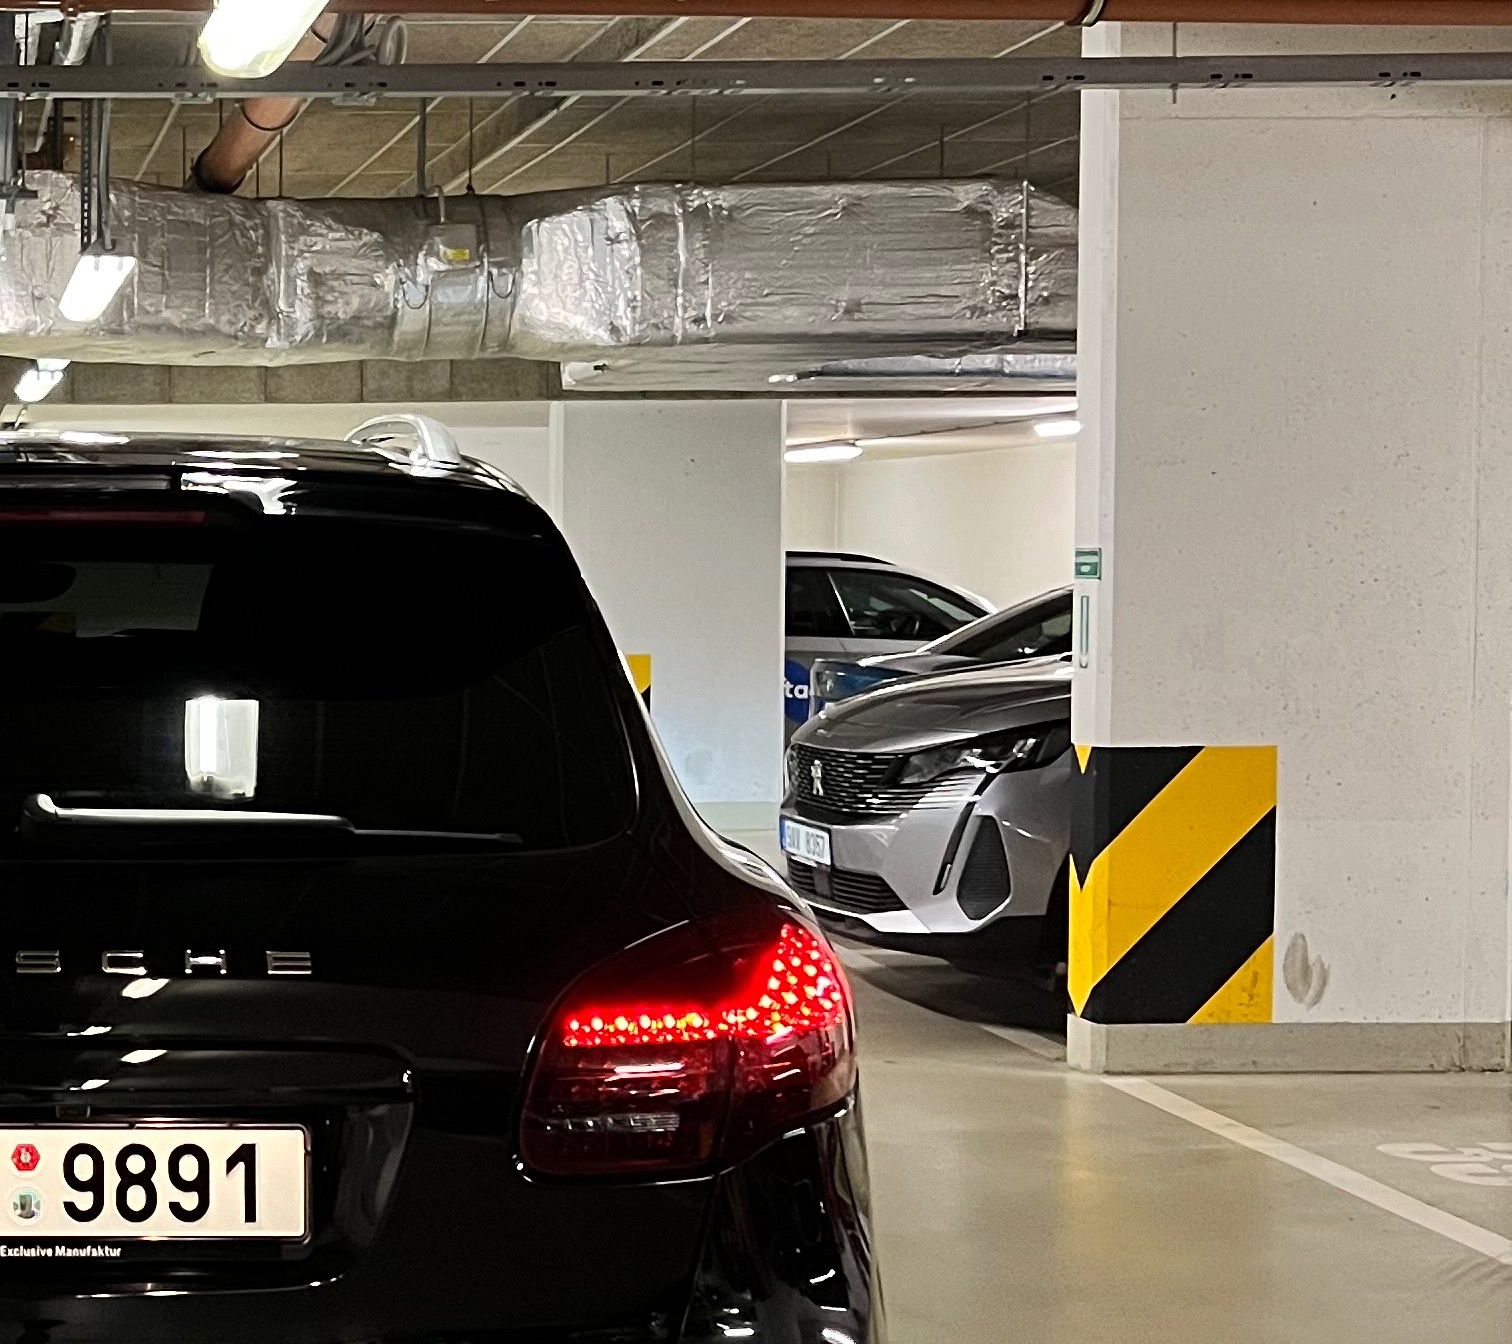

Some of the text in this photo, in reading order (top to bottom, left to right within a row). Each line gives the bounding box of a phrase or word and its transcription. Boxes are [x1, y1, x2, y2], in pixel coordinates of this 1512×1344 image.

[63, 1143, 257, 1223] 9891
[0, 1245, 53, 1257] Exclusive
[55, 1245, 121, 1257] Manufaktur
